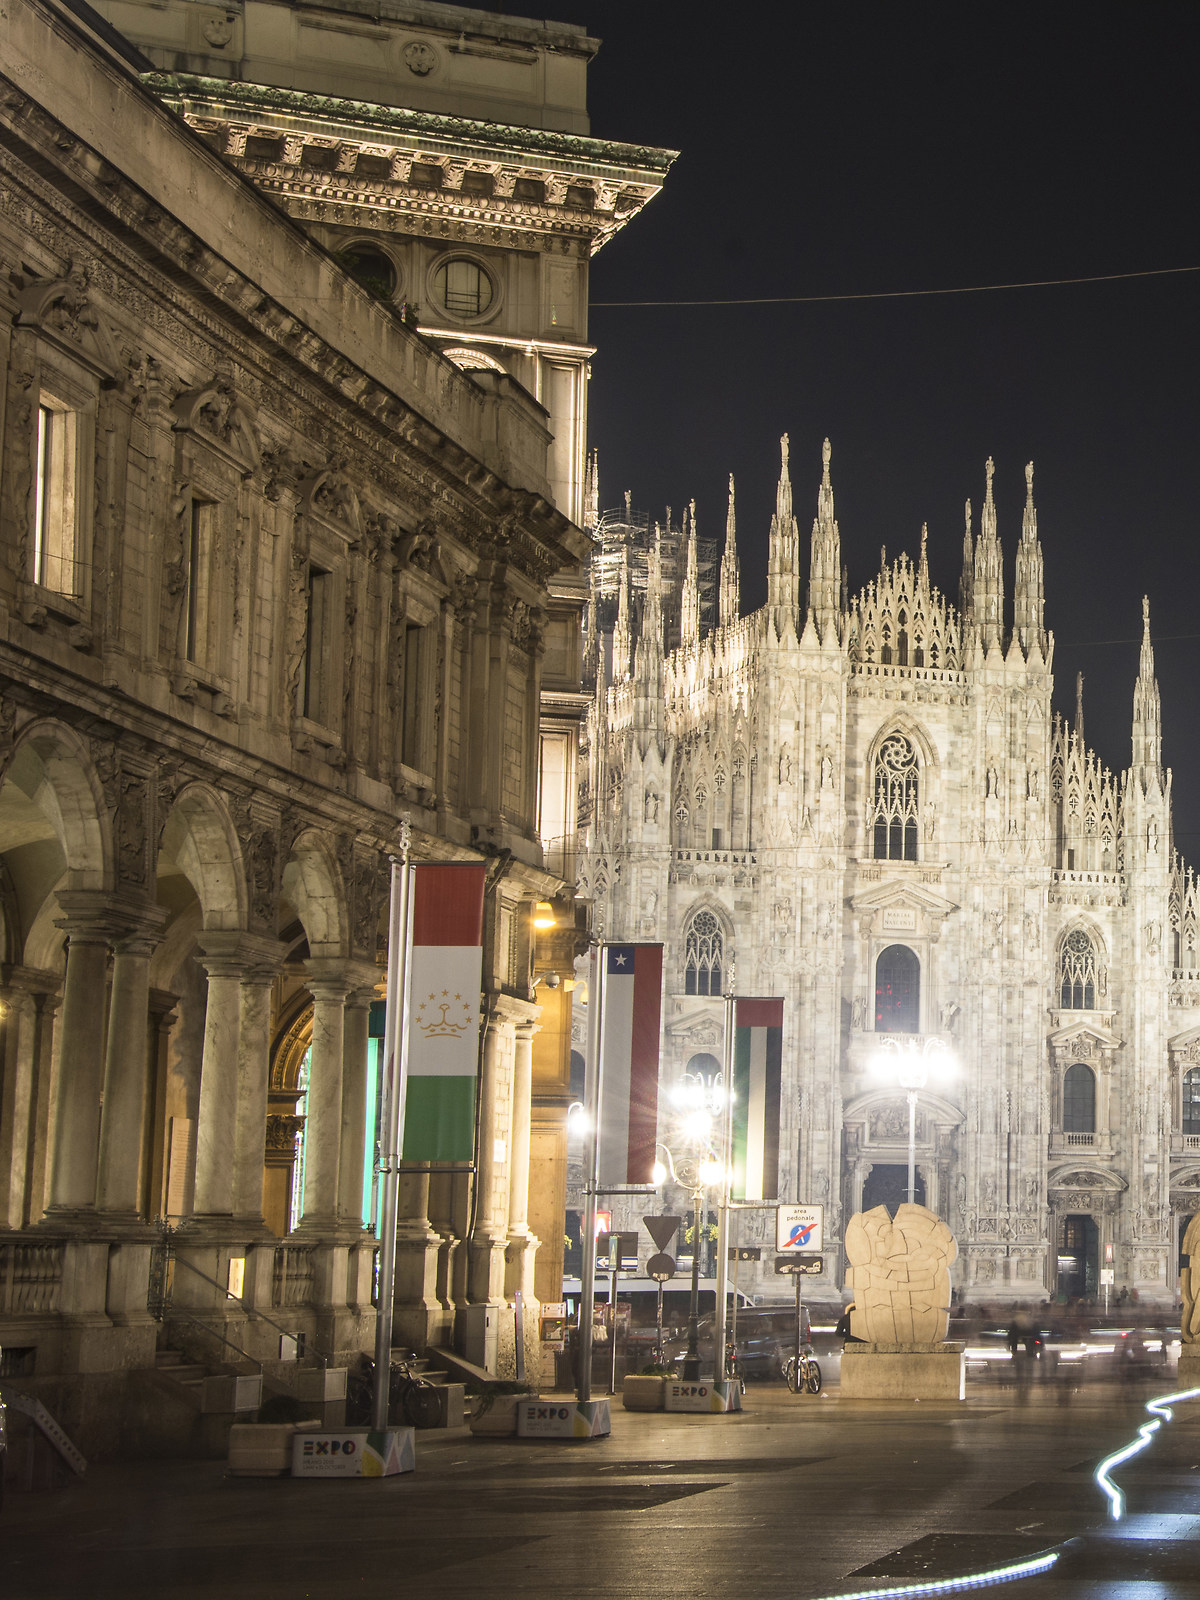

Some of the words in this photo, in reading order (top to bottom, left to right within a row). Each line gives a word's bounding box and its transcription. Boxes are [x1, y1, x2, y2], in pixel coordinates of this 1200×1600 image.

[672, 1386, 708, 1397] EXPO
[527, 1407, 569, 1420] EXPO
[303, 1440, 356, 1456] EXPO
